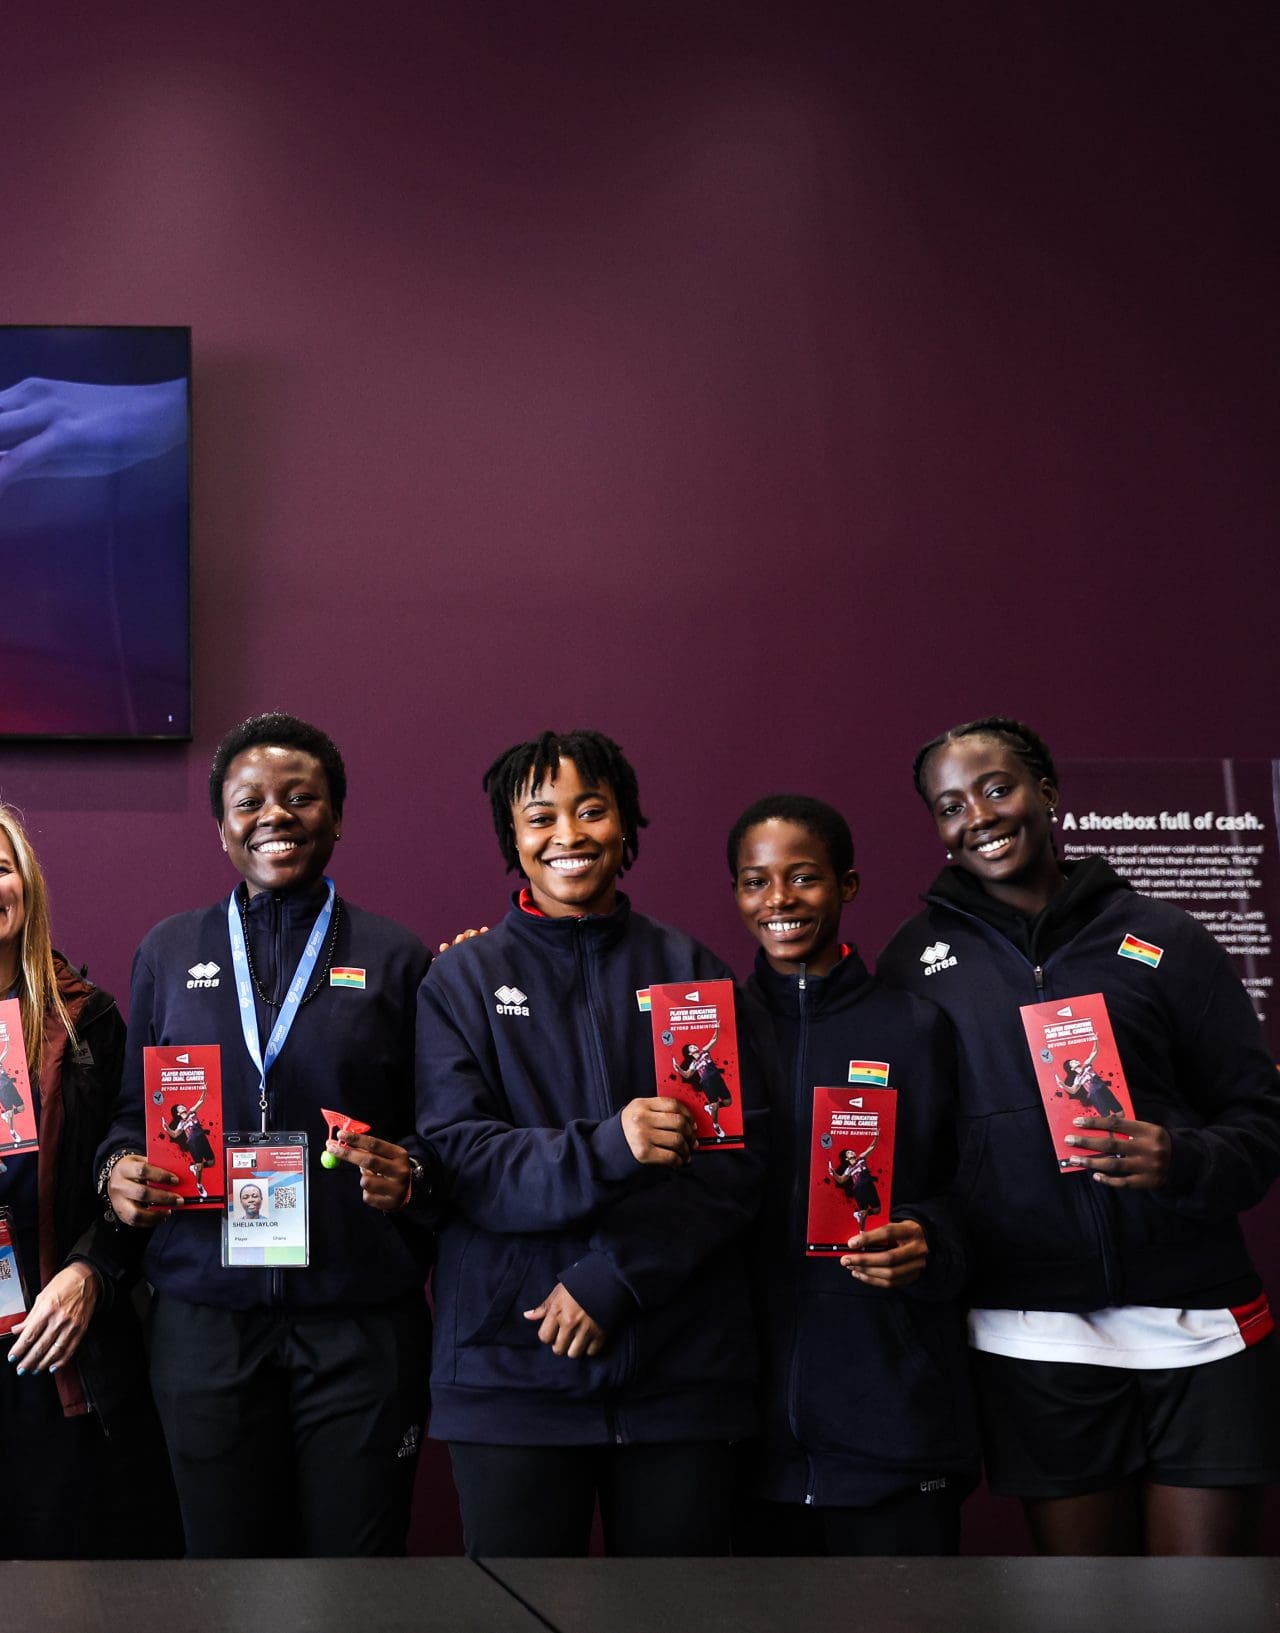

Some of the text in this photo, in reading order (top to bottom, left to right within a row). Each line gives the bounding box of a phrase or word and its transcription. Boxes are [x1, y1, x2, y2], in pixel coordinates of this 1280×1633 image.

[1062, 811, 1265, 831] A shoebox full of cash.
